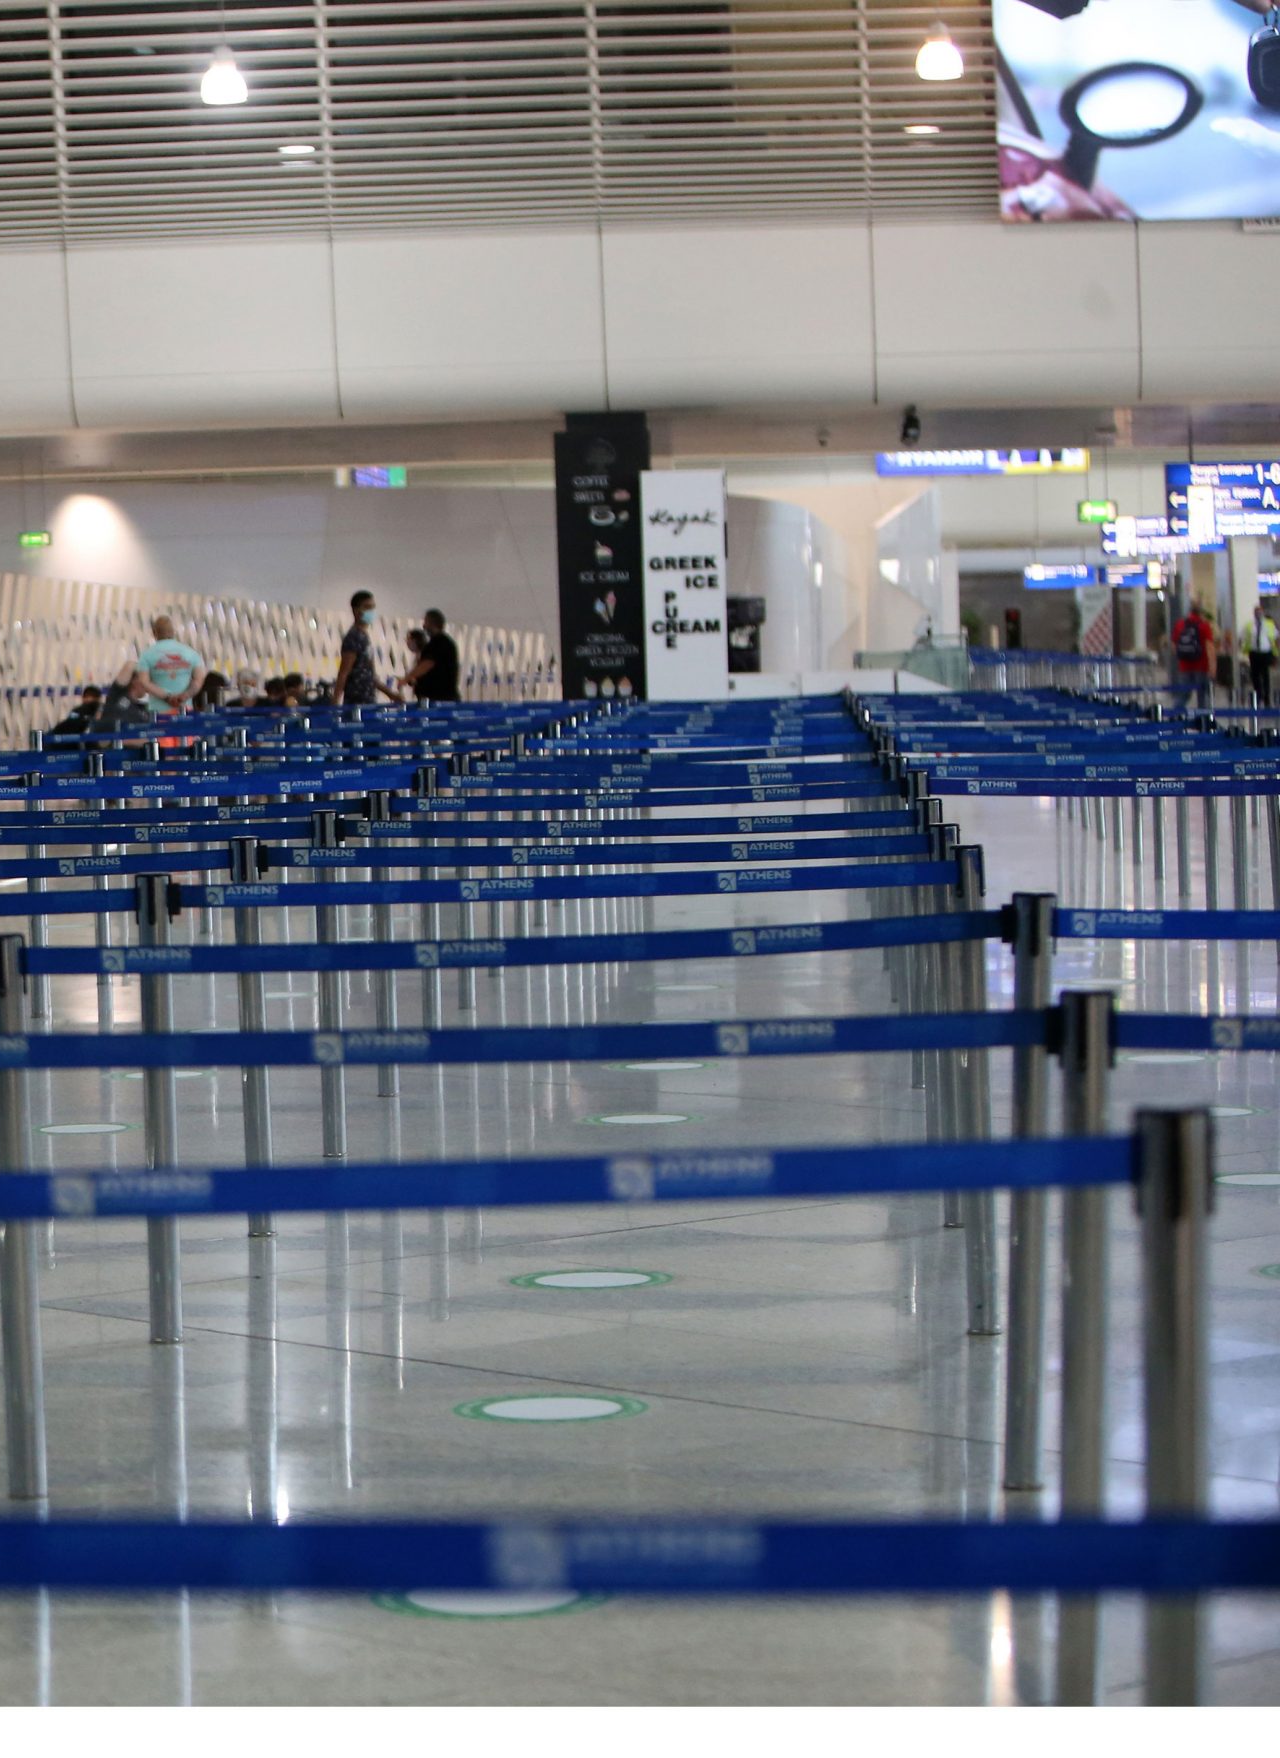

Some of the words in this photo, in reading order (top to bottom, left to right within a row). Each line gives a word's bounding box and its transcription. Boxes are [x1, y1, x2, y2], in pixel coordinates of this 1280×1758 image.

[649, 508, 718, 535] Kayak
[649, 556, 717, 571] GREEK
[685, 575, 719, 589] ICE
[651, 620, 720, 635] CREAM
[981, 781, 1017, 789] ATHENS
[431, 798, 466, 806] ATHENS
[372, 822, 412, 830] ATHENS
[563, 822, 602, 830] ATHENS
[753, 817, 793, 825] ATHENS
[150, 827, 189, 835] ATHENS
[530, 847, 575, 856] ATHENS
[749, 842, 795, 851] ATHENS
[310, 849, 356, 858] ATHENS
[76, 857, 120, 867] ATHENS
[738, 870, 792, 881] ATHENS
[481, 879, 534, 890] ATHENS
[225, 885, 278, 896] ATHENS
[1097, 912, 1164, 926] ATHENS
[756, 927, 823, 940] ATHENS
[440, 942, 506, 955] ATHENS
[125, 948, 191, 961] ATHENS
[751, 1023, 834, 1038] ATHENS
